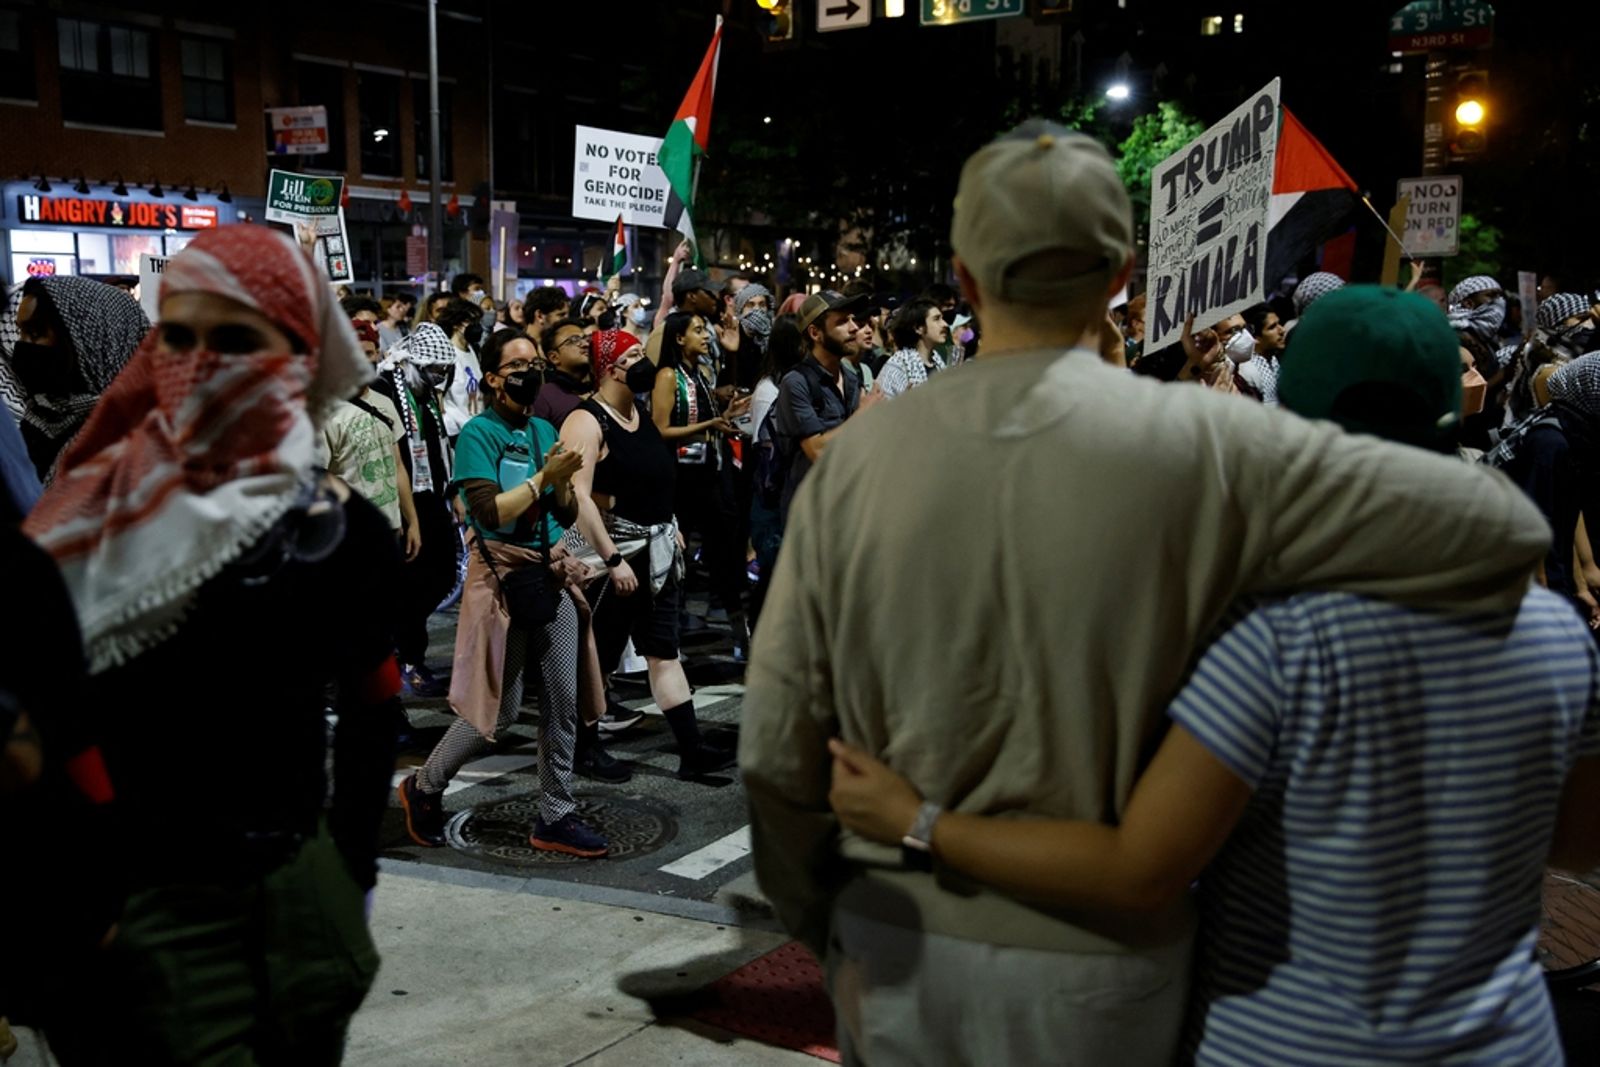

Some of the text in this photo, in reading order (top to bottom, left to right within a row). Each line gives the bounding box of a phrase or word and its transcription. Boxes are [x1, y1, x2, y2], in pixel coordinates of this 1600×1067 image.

[1415, 8, 1486, 31] 3rd St
[586, 143, 660, 166] NO VOTE
[1160, 94, 1273, 216] TRUMP
[608, 165, 641, 181] FOR
[281, 179, 304, 195] Jill
[584, 179, 664, 202] GENOCIDE
[1414, 183, 1444, 199] NO
[273, 200, 336, 213] FOR PRESIDENT
[284, 192, 312, 203] STEIN
[584, 196, 663, 214] TAKE THE PLEDGE
[23, 195, 178, 228] HANGRY JOE'S
[1408, 201, 1451, 215] TURN
[1152, 223, 1259, 343] KAMALA
